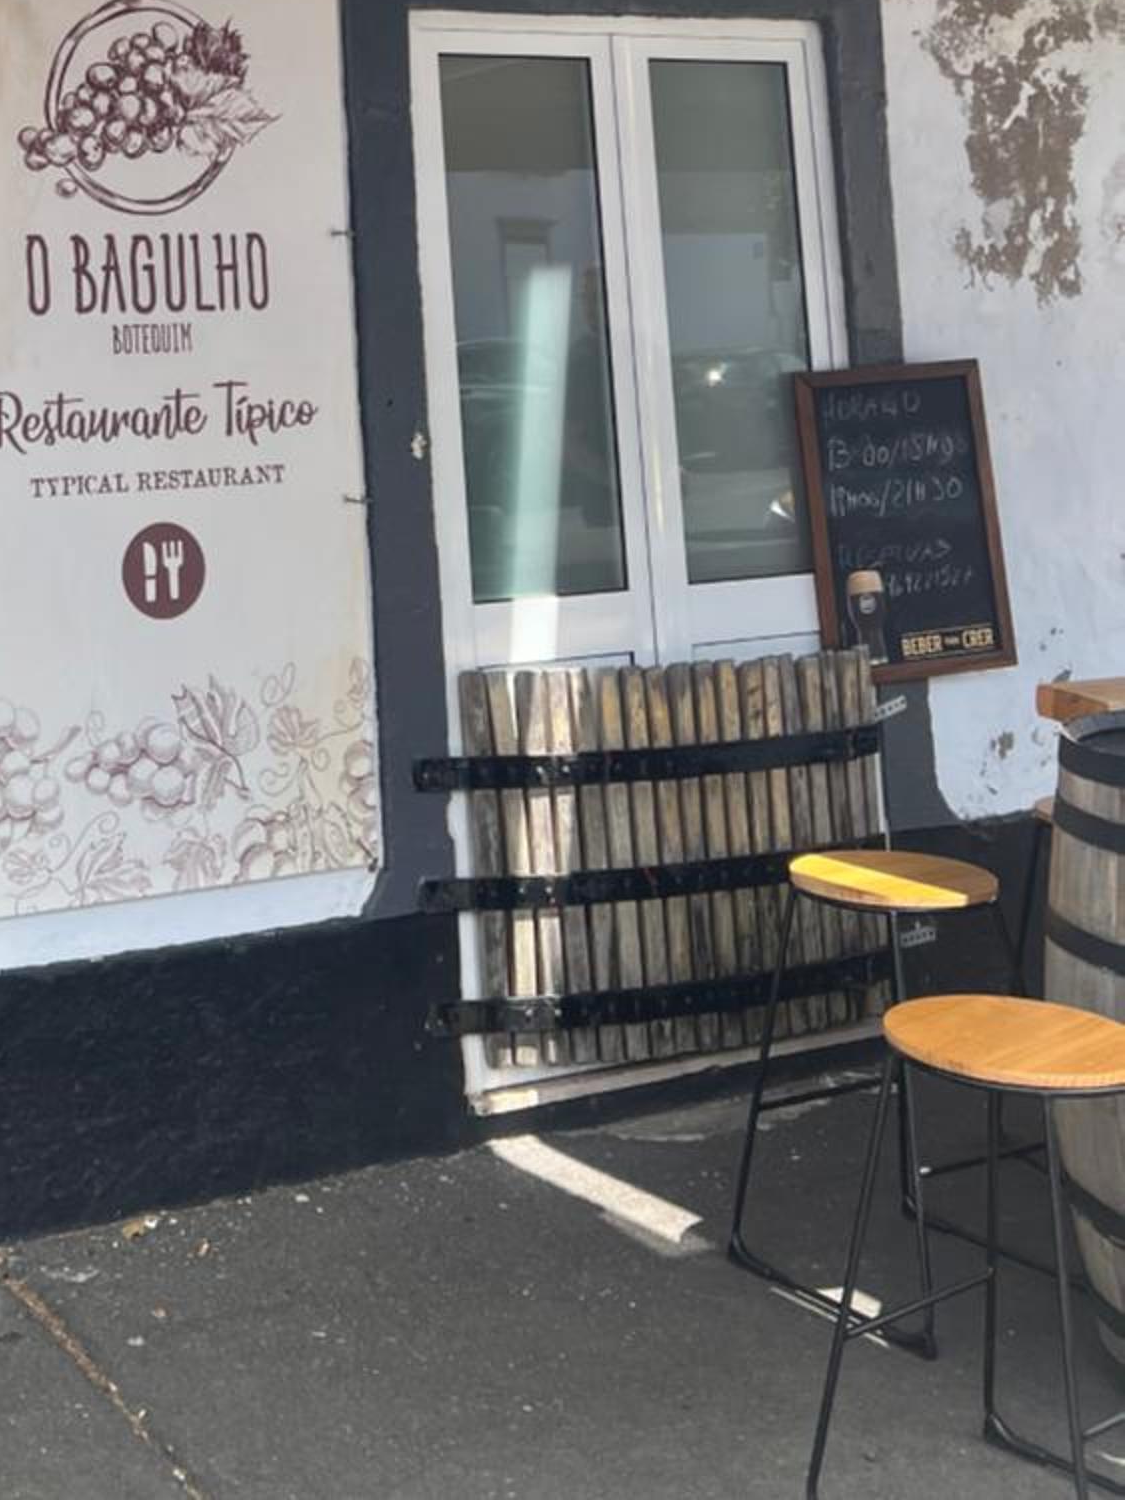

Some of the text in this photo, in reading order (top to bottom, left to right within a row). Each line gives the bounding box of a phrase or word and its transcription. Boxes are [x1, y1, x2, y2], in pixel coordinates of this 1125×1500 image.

[26, 232, 269, 315] O BAGULHO
[112, 322, 193, 354] BOTEQUIM
[213, 380, 317, 445] Típico
[30, 464, 285, 498] TYPICAL RESTAURANT
